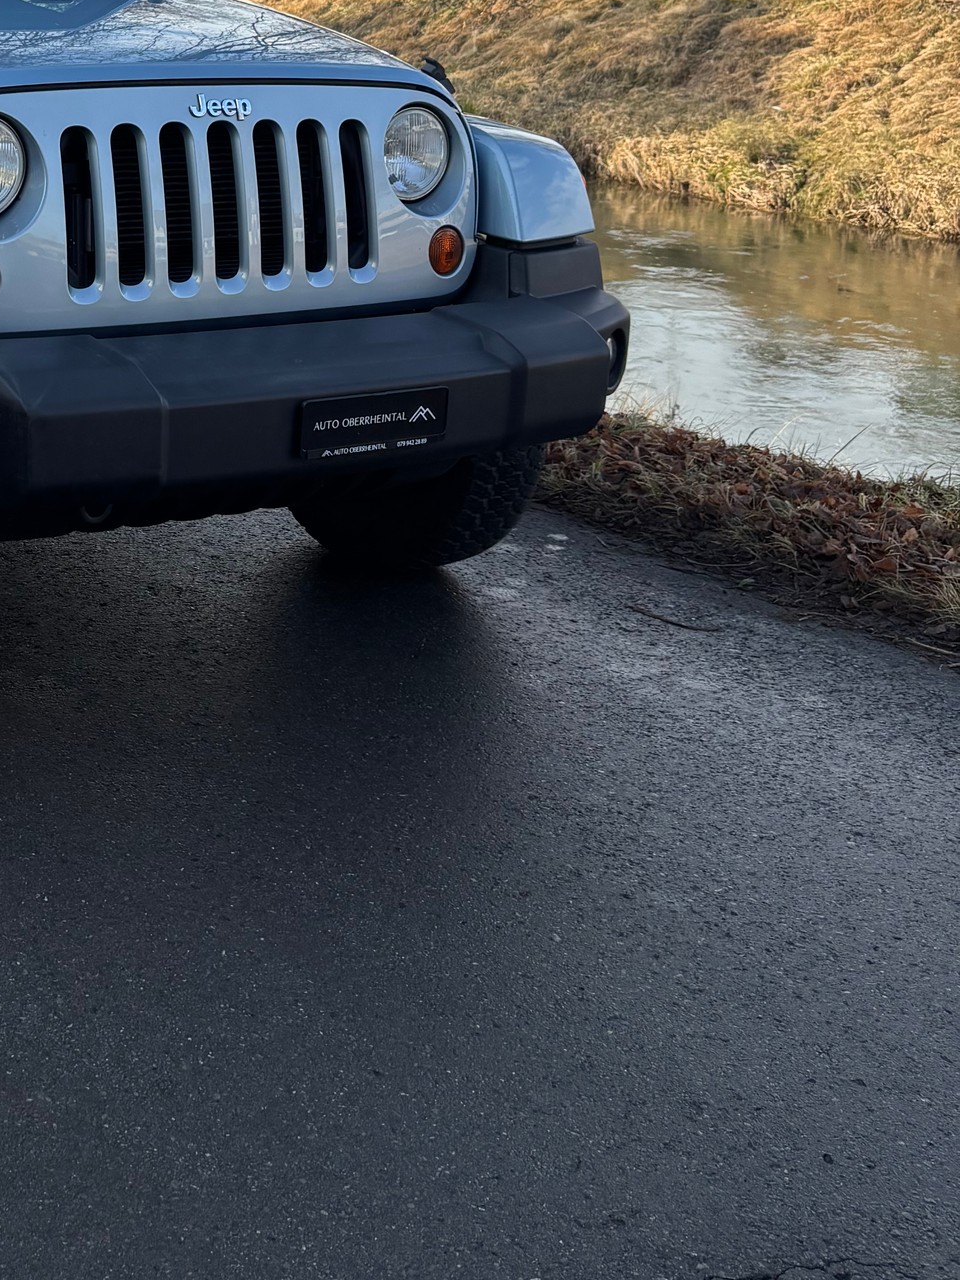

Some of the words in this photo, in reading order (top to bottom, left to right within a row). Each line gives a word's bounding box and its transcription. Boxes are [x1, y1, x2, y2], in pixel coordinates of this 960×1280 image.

[188, 93, 252, 121] Jeep
[313, 419, 340, 431] AUTO
[342, 412, 408, 428] OBERRHEINTAL
[333, 446, 349, 456] AUTO
